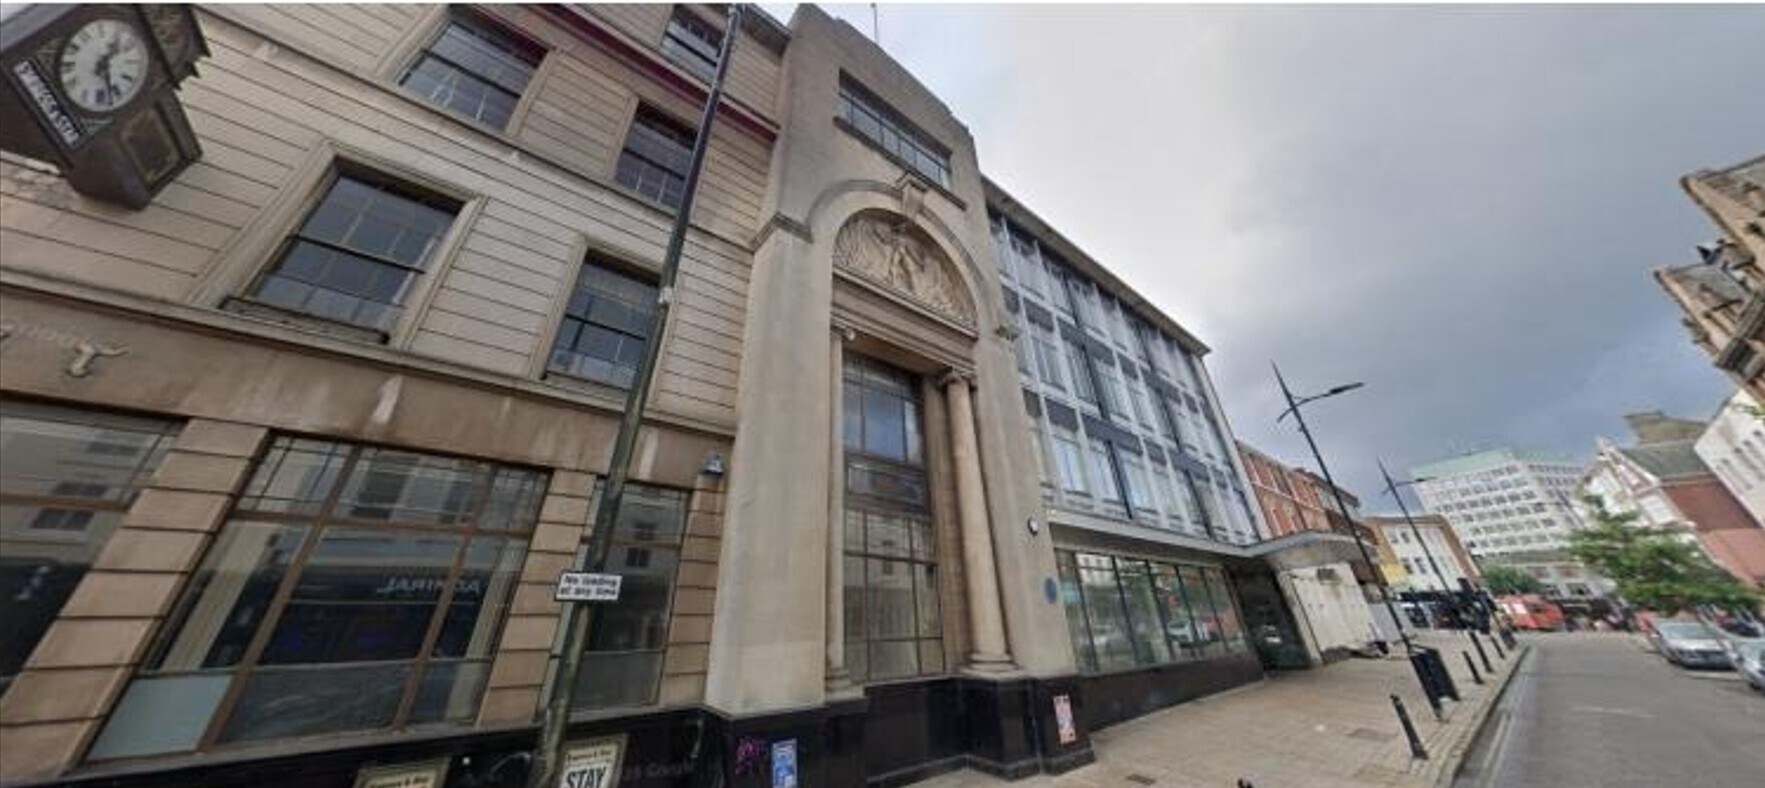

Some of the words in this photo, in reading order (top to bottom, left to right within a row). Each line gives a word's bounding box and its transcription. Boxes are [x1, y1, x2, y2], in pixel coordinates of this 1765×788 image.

[565, 575, 578, 584] No
[582, 576, 617, 587] loading
[560, 586, 571, 595] at
[575, 587, 592, 597] any
[596, 586, 616, 595] time
[566, 765, 607, 788] STAY
